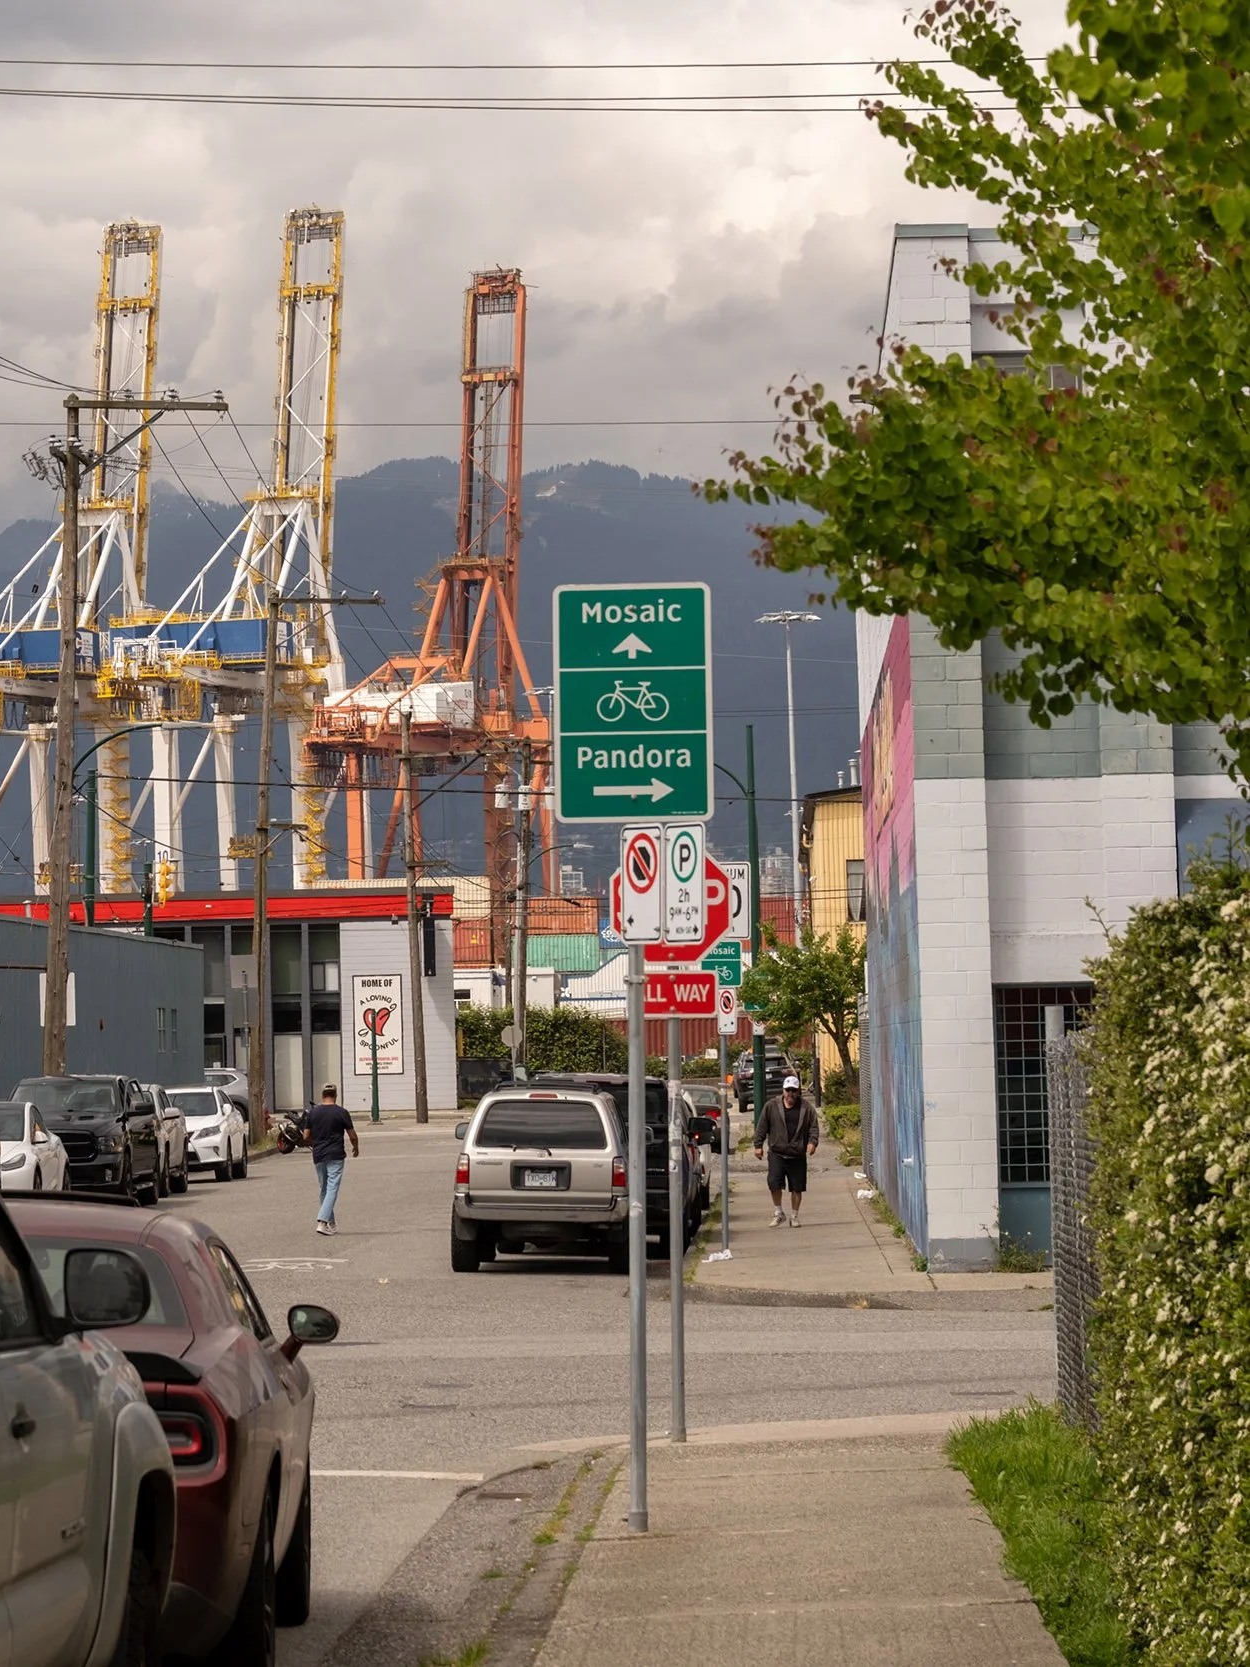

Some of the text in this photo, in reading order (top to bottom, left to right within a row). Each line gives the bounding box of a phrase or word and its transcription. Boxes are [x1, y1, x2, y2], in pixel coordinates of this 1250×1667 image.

[582, 599, 682, 624] Mosaic
[577, 744, 692, 769] Pandora
[680, 844, 691, 872] P
[678, 888, 690, 903] 2h
[710, 945, 735, 955] osaic
[361, 979, 393, 987] HOME OF
[365, 994, 393, 1004] LOVING
[644, 984, 710, 1003] LL WAY
